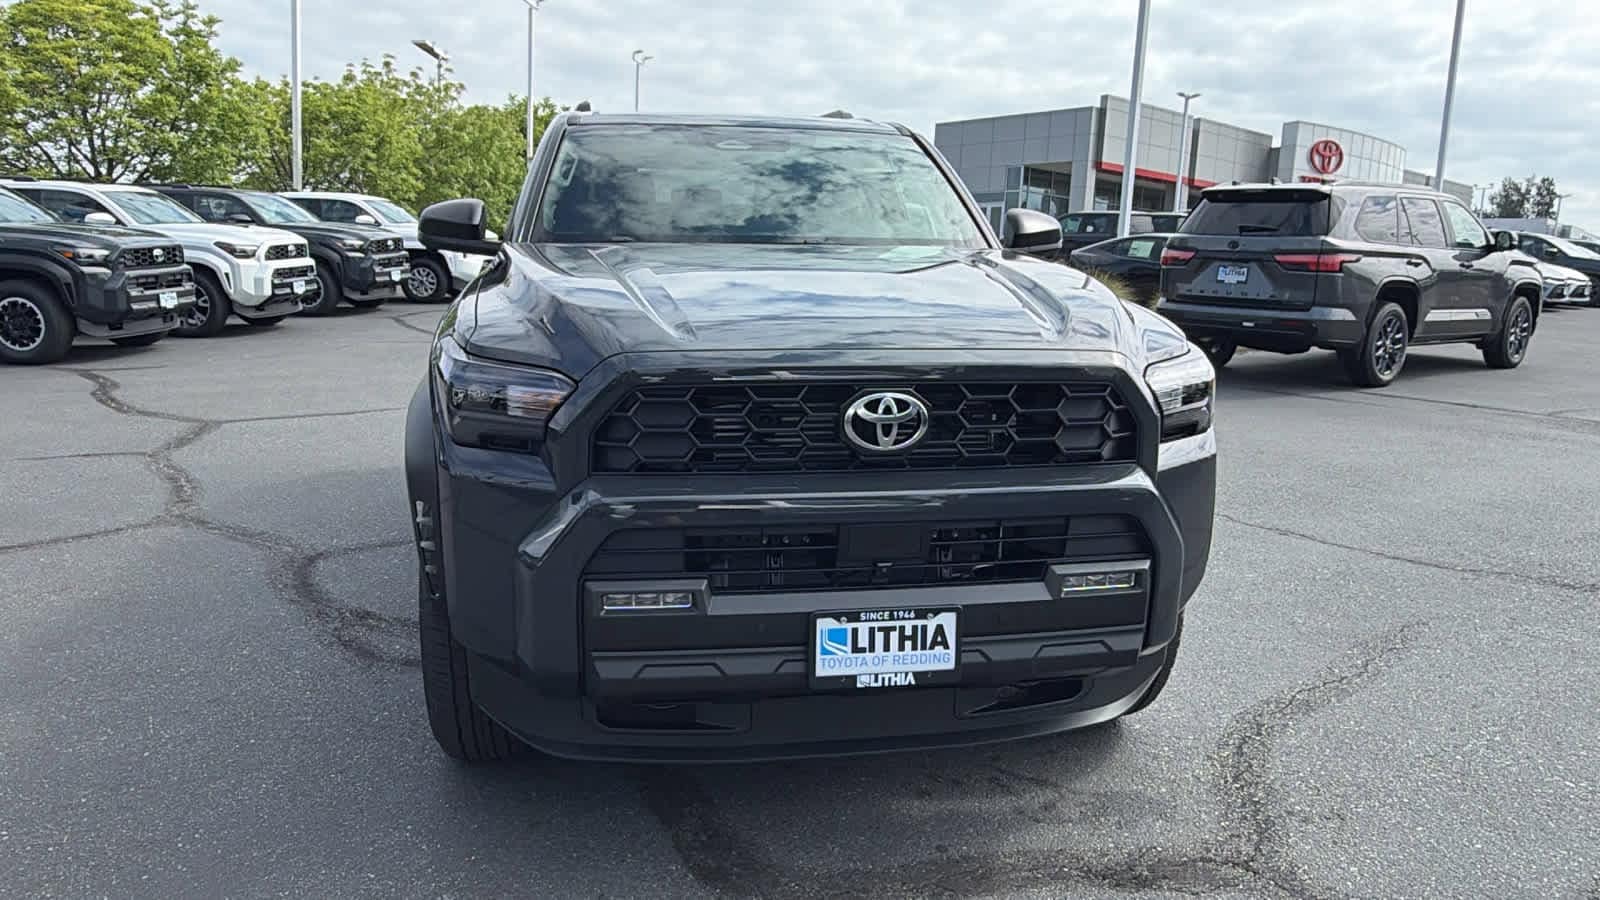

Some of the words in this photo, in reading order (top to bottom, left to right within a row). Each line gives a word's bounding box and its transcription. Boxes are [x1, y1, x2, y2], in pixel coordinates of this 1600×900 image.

[860, 611, 889, 621] SINCE
[893, 610, 916, 620] 1946
[851, 623, 949, 654] LITHIA
[820, 656, 868, 670] TOYOTA
[872, 655, 889, 667] OF
[893, 653, 951, 666] REDDING
[871, 672, 916, 687] LITHIA
